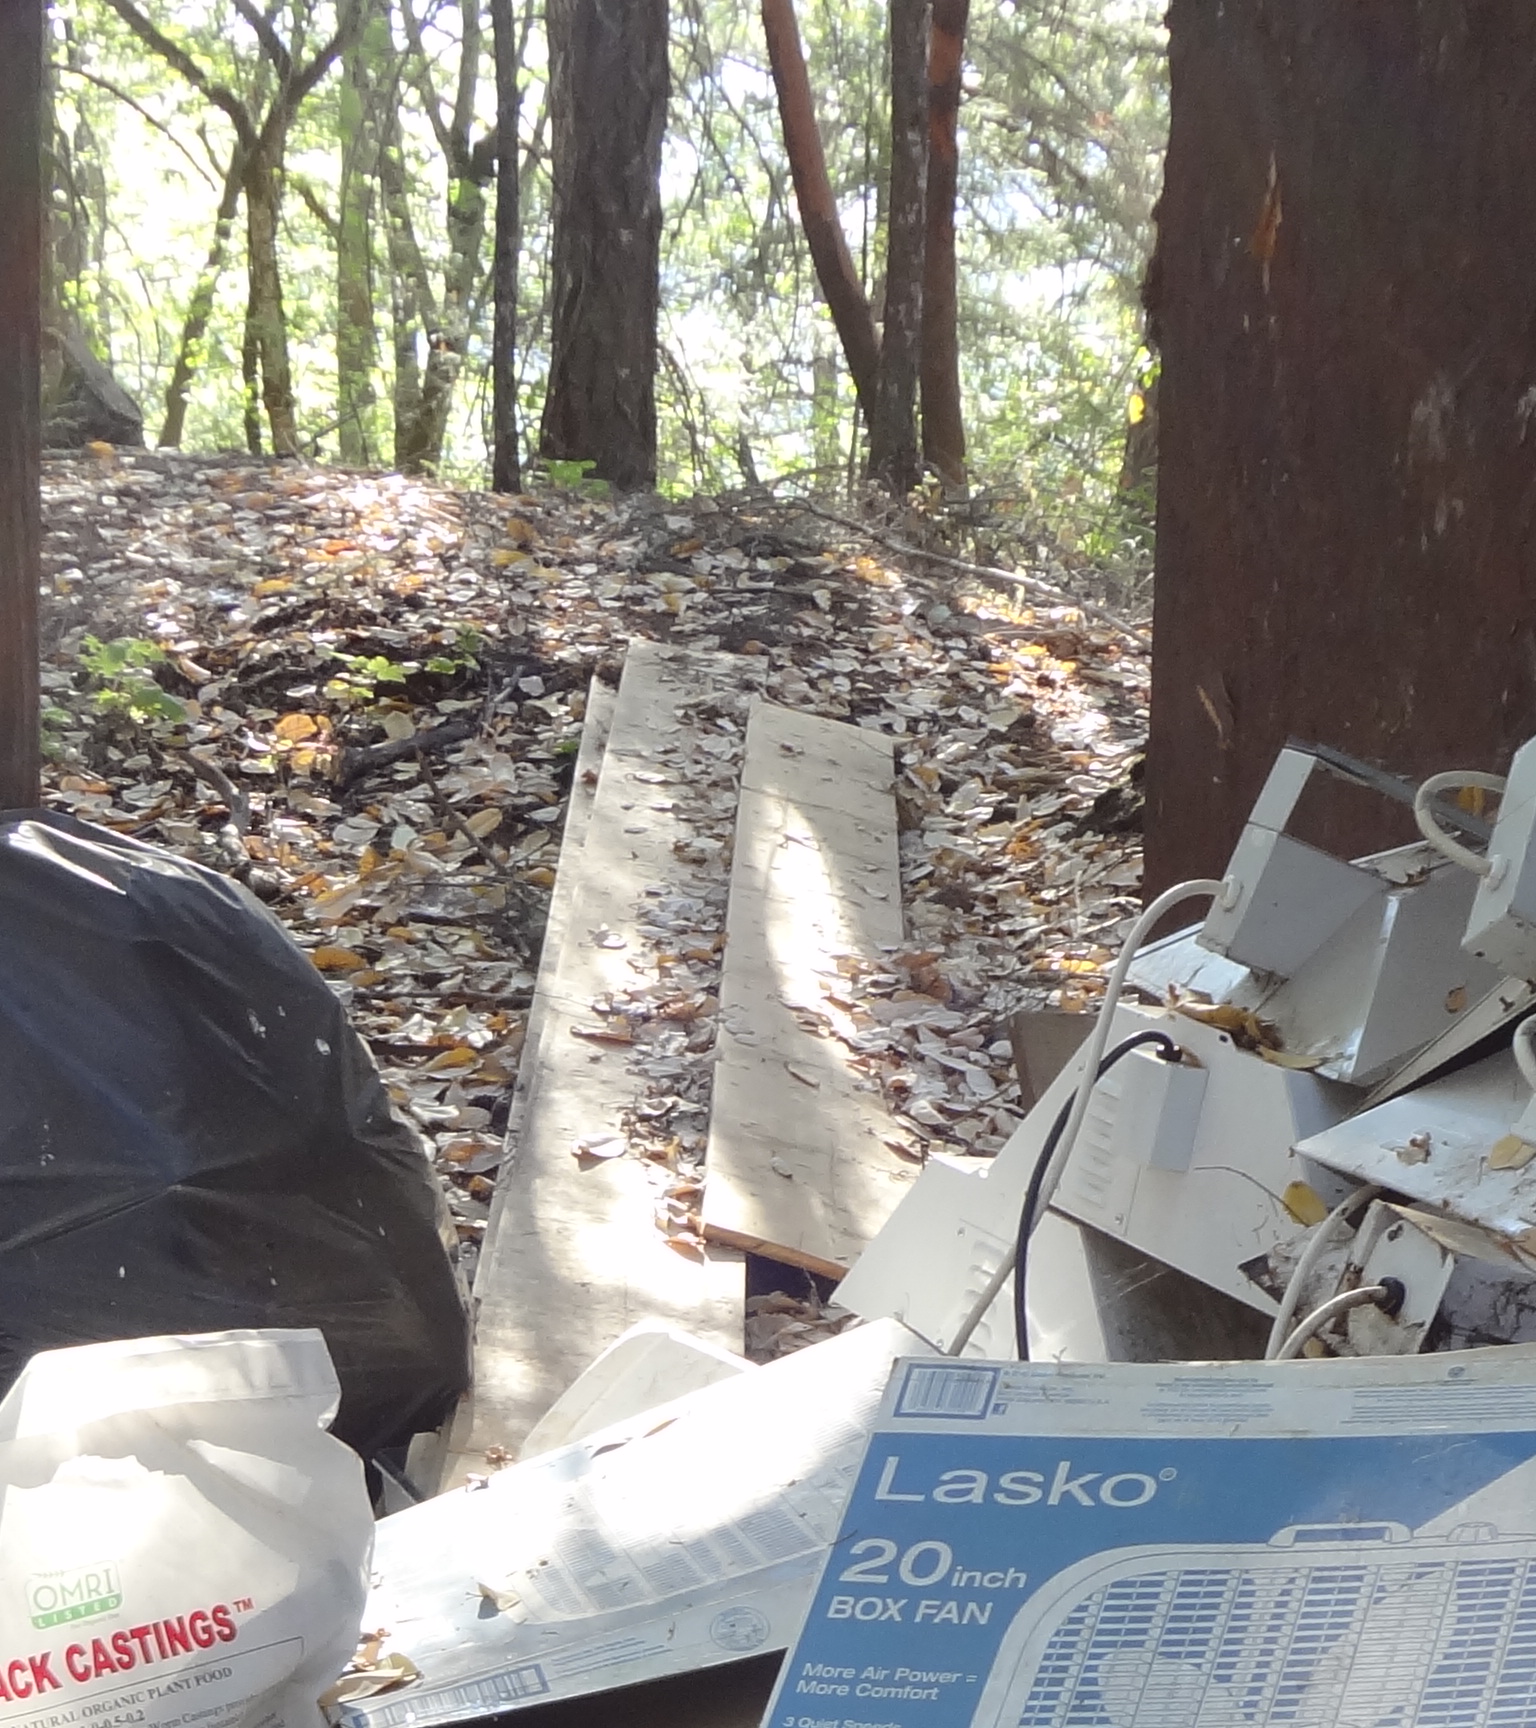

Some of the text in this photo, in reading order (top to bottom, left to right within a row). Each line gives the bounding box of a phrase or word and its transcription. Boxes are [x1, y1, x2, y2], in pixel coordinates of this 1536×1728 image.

[839, 1538, 1027, 1589] 20 inch
[32, 1568, 117, 1612] OMRI
[36, 1596, 119, 1629] LISTED
[827, 1595, 993, 1625] BOX FAN
[64, 1604, 238, 1684] CASTINGS
[802, 1663, 962, 1683] More Air Power
[81, 1689, 147, 1720] ORGANIC
[147, 1678, 193, 1701] PLANT
[195, 1666, 234, 1688] FOOD
[796, 1680, 940, 1700] More Comfort
[782, 1716, 795, 1728] 3
